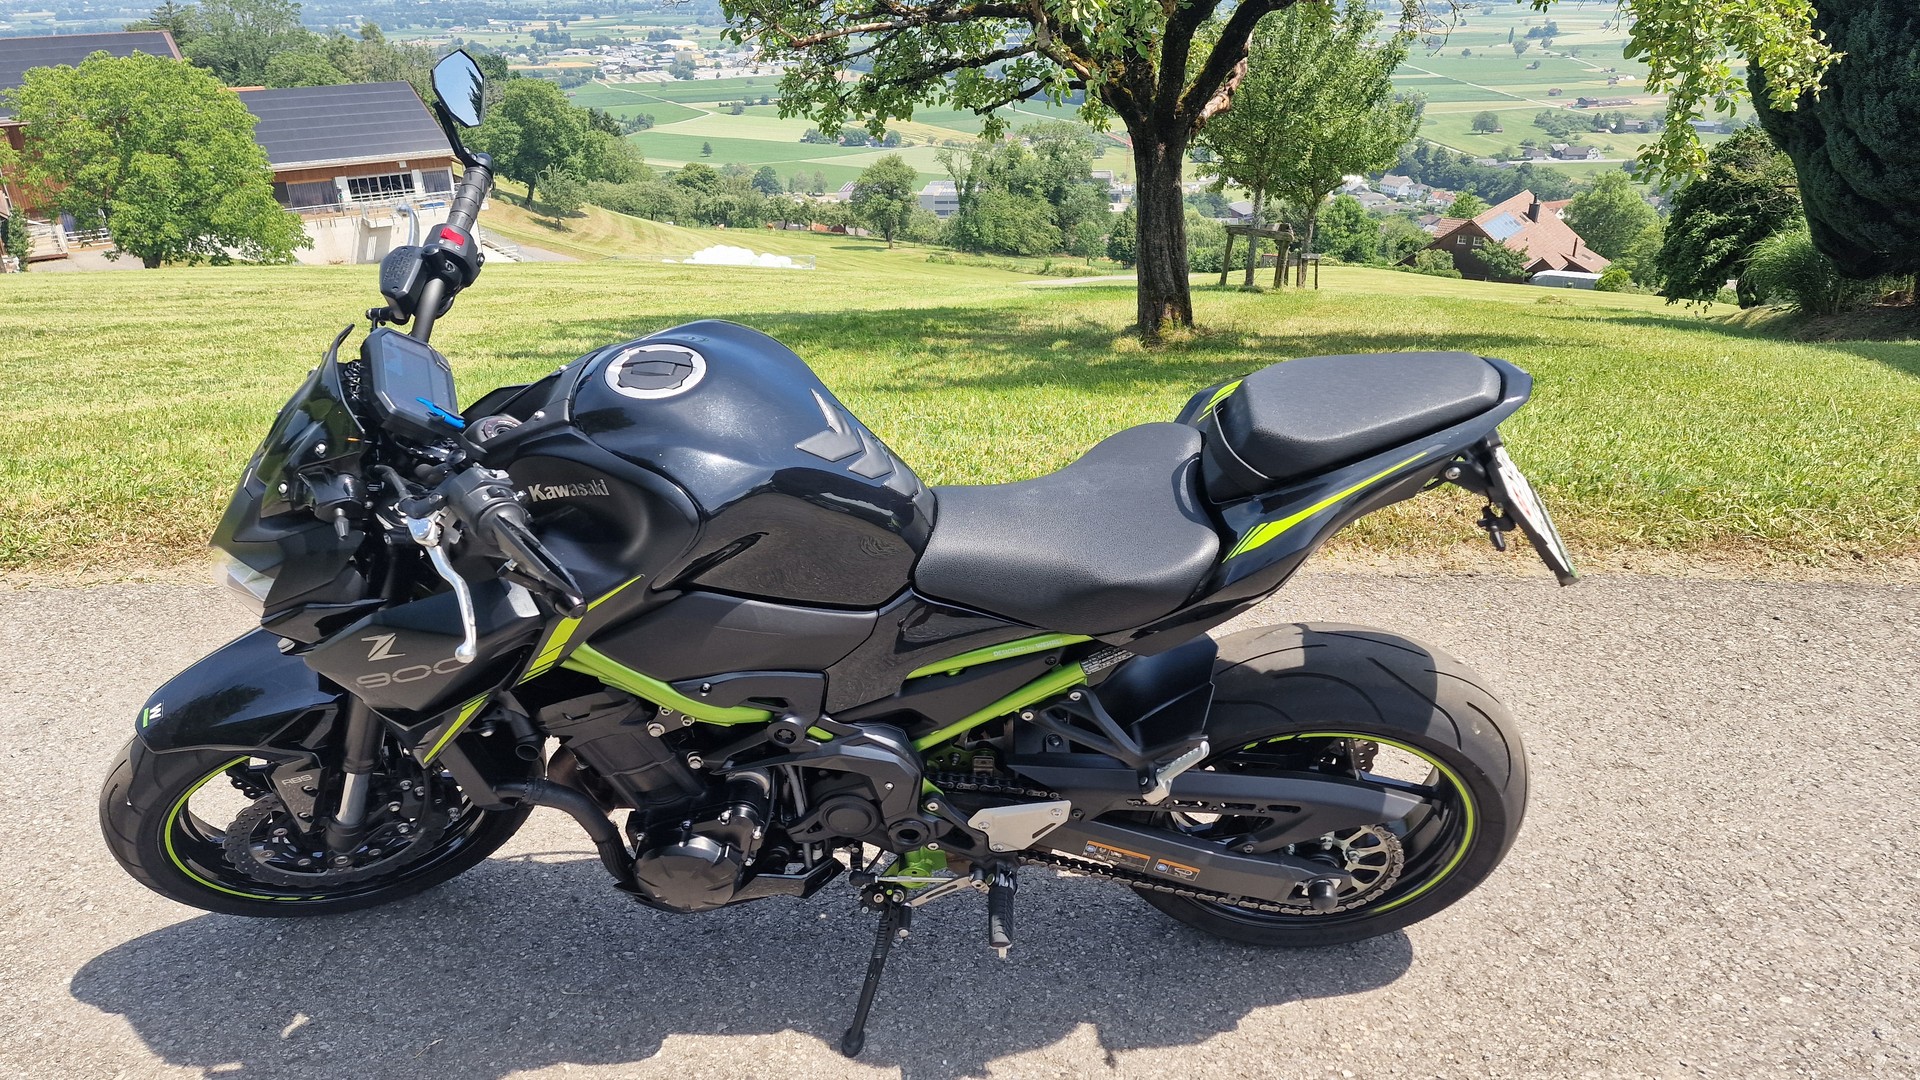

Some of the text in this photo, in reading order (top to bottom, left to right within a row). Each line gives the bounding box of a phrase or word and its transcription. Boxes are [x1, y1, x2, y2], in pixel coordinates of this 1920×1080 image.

[527, 479, 610, 503] Kawasaki
[361, 632, 406, 662] Z
[356, 657, 470, 689] 900
[281, 774, 313, 786] ABS
